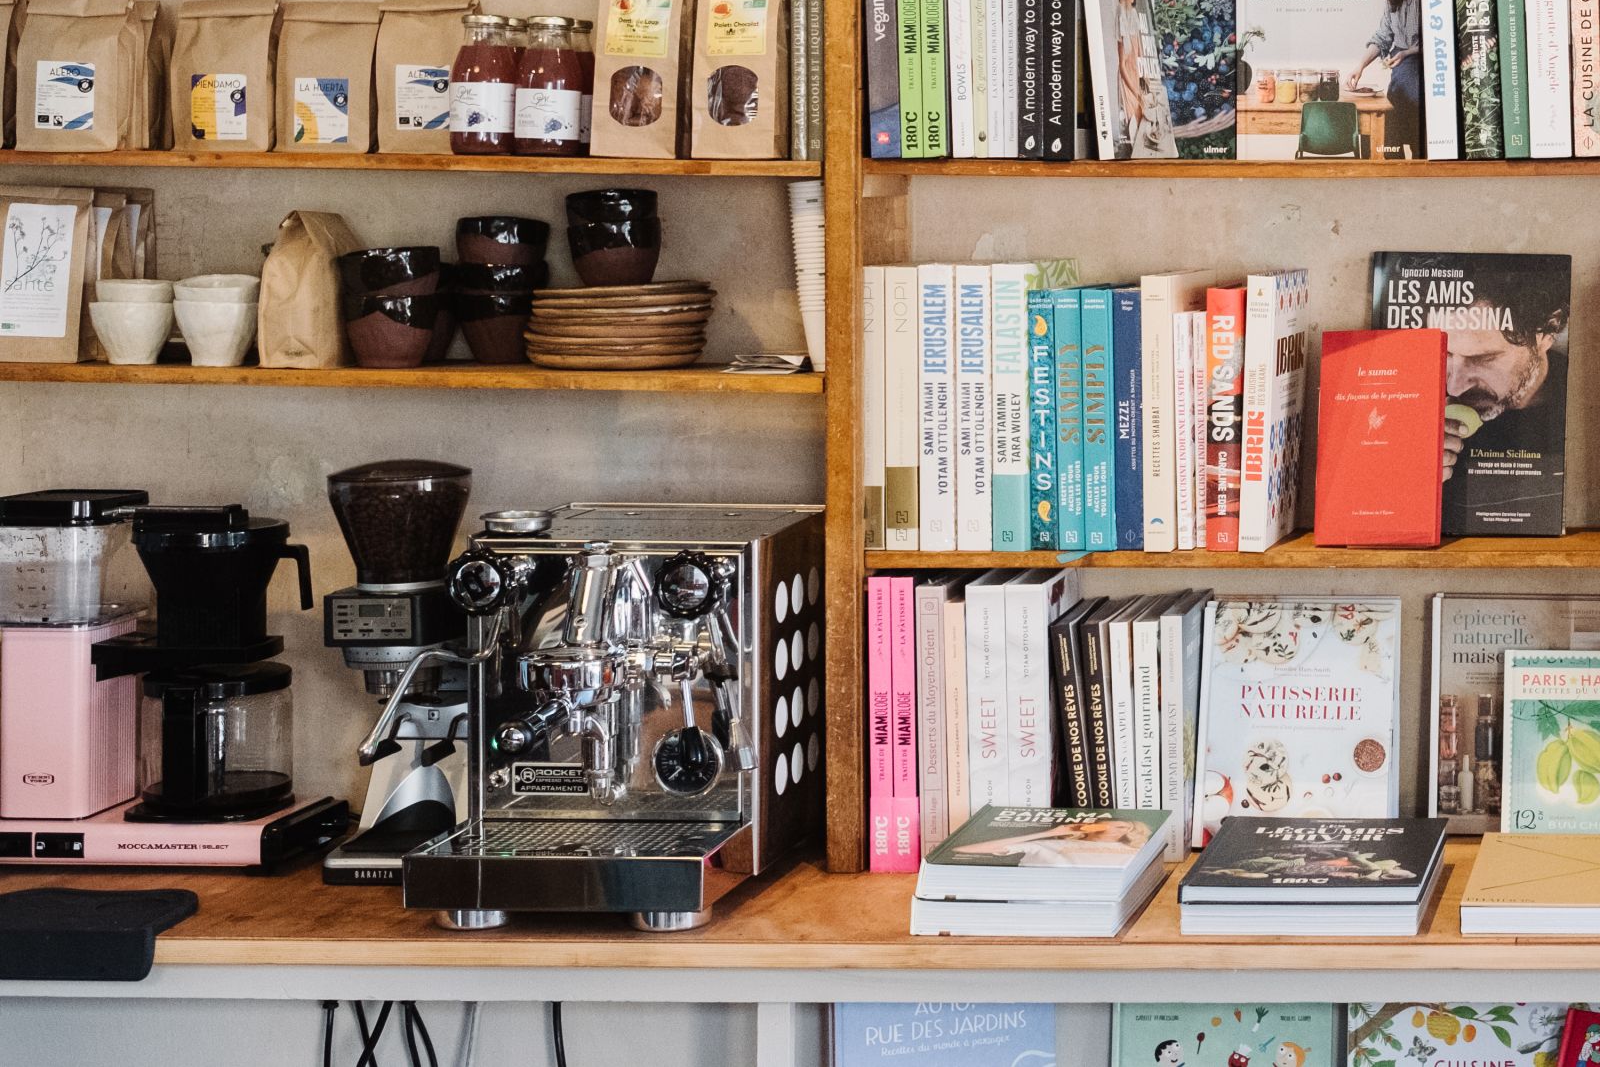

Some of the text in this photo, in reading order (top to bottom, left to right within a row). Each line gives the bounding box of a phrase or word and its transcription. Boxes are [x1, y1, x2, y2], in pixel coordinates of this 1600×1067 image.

[1025, 6, 1036, 22] to
[1430, 14, 1443, 31] &
[1024, 25, 1038, 56] way
[1432, 37, 1449, 97] Happy
[1024, 60, 1035, 108] modern
[1023, 113, 1034, 122] A
[1401, 267, 1464, 279] Ignazio Messina
[1388, 280, 1474, 305] LES AMIS
[996, 279, 1022, 376] FALASTIN
[1387, 305, 1514, 331] DES MESSINA
[924, 283, 947, 375] JERUSALEM
[1211, 315, 1235, 443] RED SANDS
[1357, 367, 1398, 376] le sumac
[1470, 449, 1541, 459] L'Anima Siciliana
[1452, 609, 1527, 628] épicerie
[1452, 628, 1534, 645] naturelle
[1522, 673, 1566, 687] PARIS
[1240, 681, 1362, 702] PÂTISSERIE
[1240, 704, 1362, 721] NATURELLE
[981, 697, 997, 759] SWEET
[535, 768, 583, 776] ROCKET
[1513, 810, 1536, 830] 12
[118, 843, 197, 851] MOCCAMASTER
[354, 870, 393, 881] BARATZA
[865, 1010, 1026, 1046] RUE DES JARDINS
